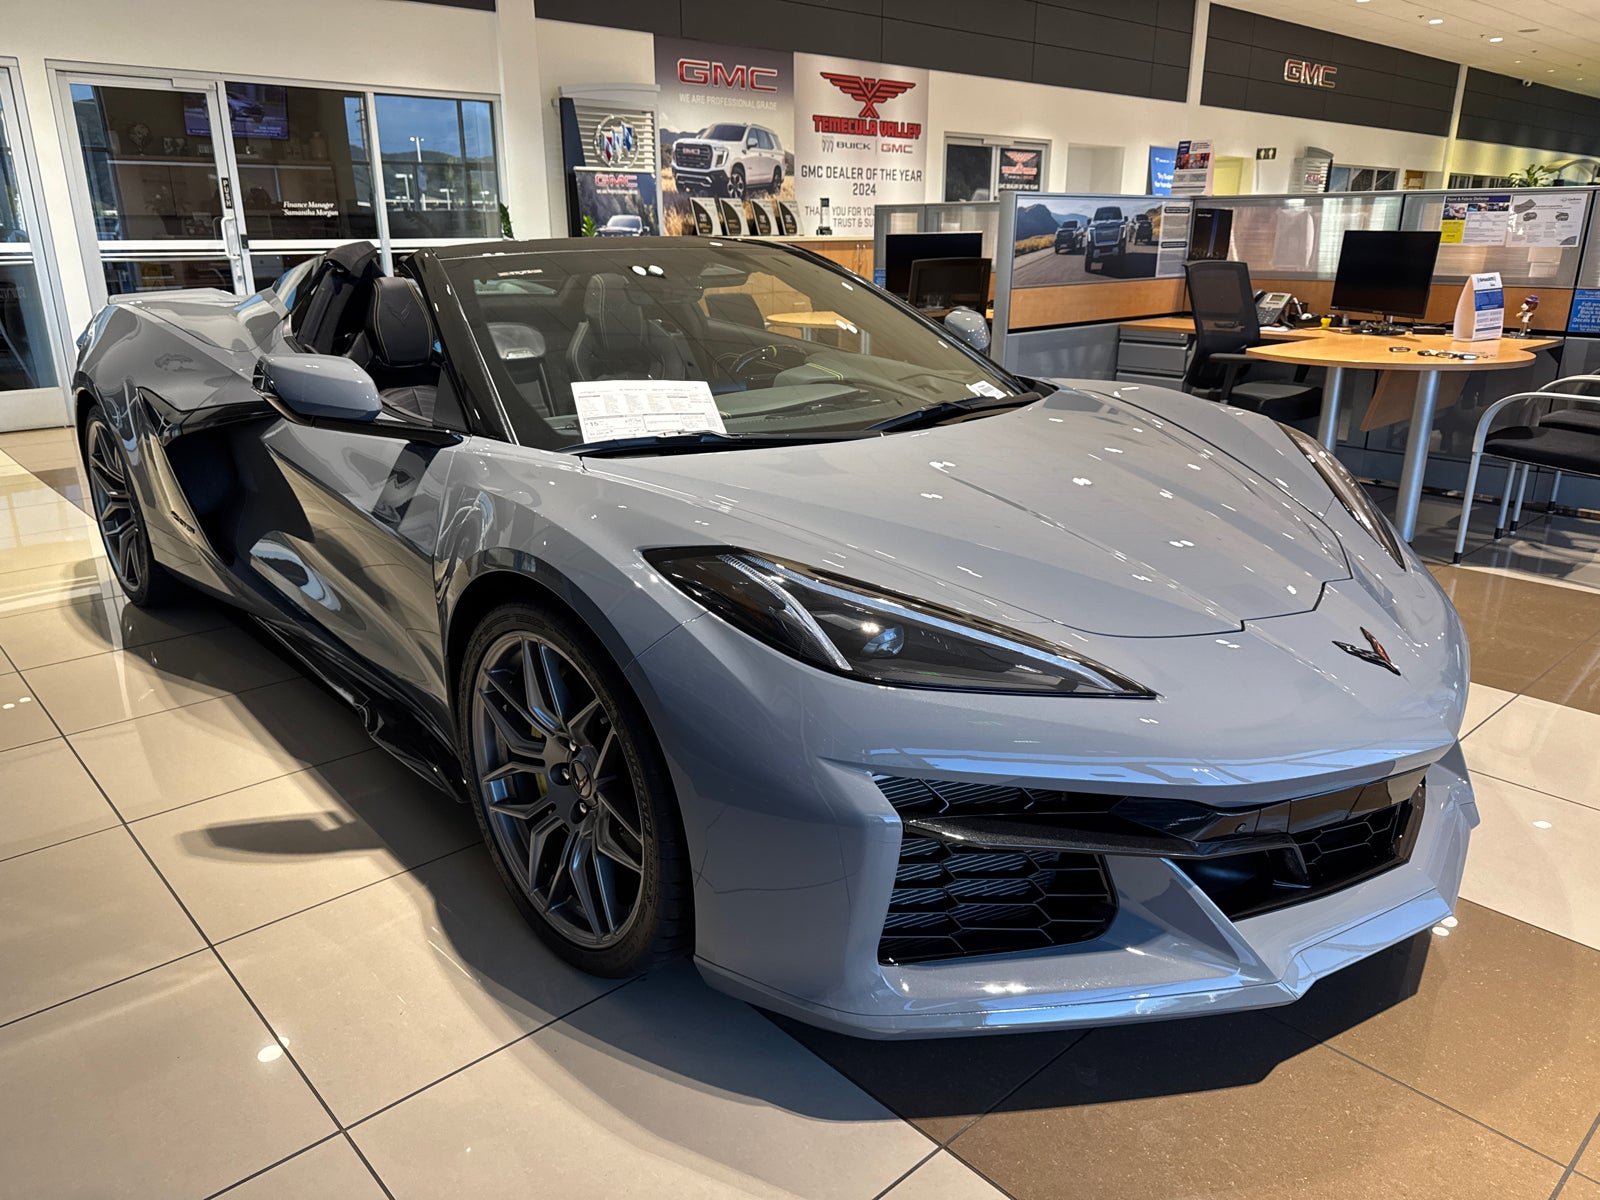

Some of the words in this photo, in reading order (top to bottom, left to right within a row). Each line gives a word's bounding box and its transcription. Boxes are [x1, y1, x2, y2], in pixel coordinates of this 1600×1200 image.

[677, 58, 778, 93] GMC
[1284, 58, 1337, 88] GMC
[679, 93, 690, 103] WE
[691, 95, 705, 105] ARE
[706, 96, 755, 110] PROFESSIONAL
[756, 99, 777, 111] GRADE
[812, 115, 877, 137] TEMECULA
[879, 120, 922, 140] VALLEY
[836, 141, 871, 150] BUICK
[881, 143, 913, 154] GMC
[801, 165, 823, 178] GMC
[826, 166, 863, 180] DEALER
[866, 168, 878, 180] OF
[880, 169, 897, 181] THE
[899, 169, 922, 182] YEAR
[594, 174, 638, 187] GMC
[222, 179, 232, 207] PUSH
[852, 183, 876, 196] 2024
[283, 201, 308, 209] Finance
[308, 201, 335, 210] Manager
[832, 206, 847, 217] YOU
[848, 206, 862, 217] FOR
[283, 208, 315, 216] Samantha
[316, 209, 339, 217] Morgan
[833, 217, 857, 228] TRUST
[624, 742, 653, 834] MICHELIN
